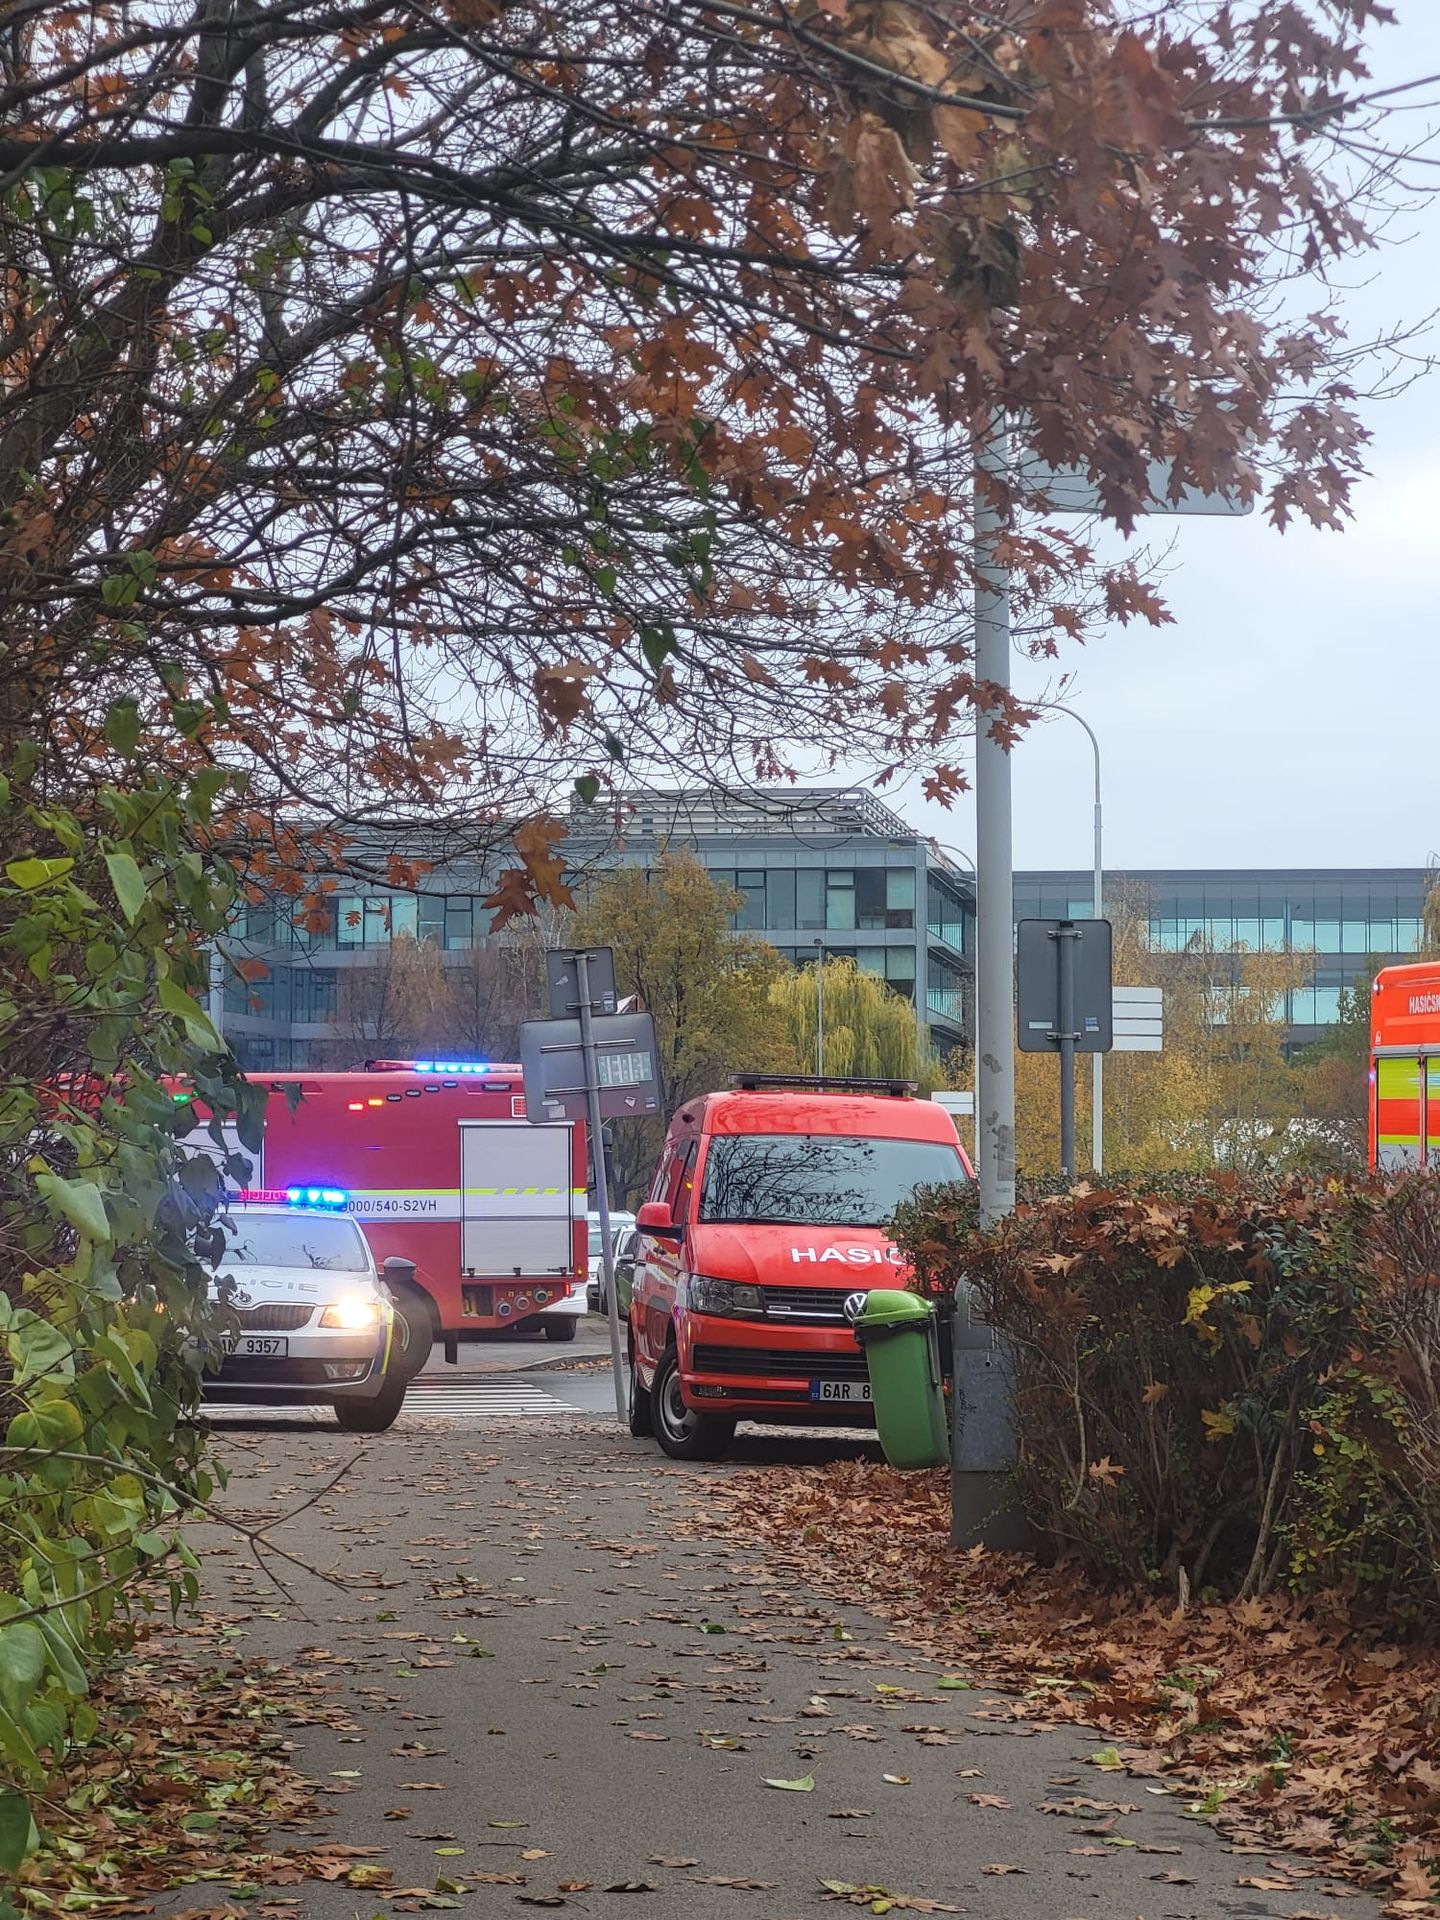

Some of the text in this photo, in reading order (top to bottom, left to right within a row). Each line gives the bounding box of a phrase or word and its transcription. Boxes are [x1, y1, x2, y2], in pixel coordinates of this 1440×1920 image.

[790, 1246, 910, 1266] HASIČ
[237, 1278, 320, 1293] ICIE
[246, 1339, 280, 1354] 9357
[823, 1383, 851, 1399] 6AR
[862, 1384, 871, 1400] 8
